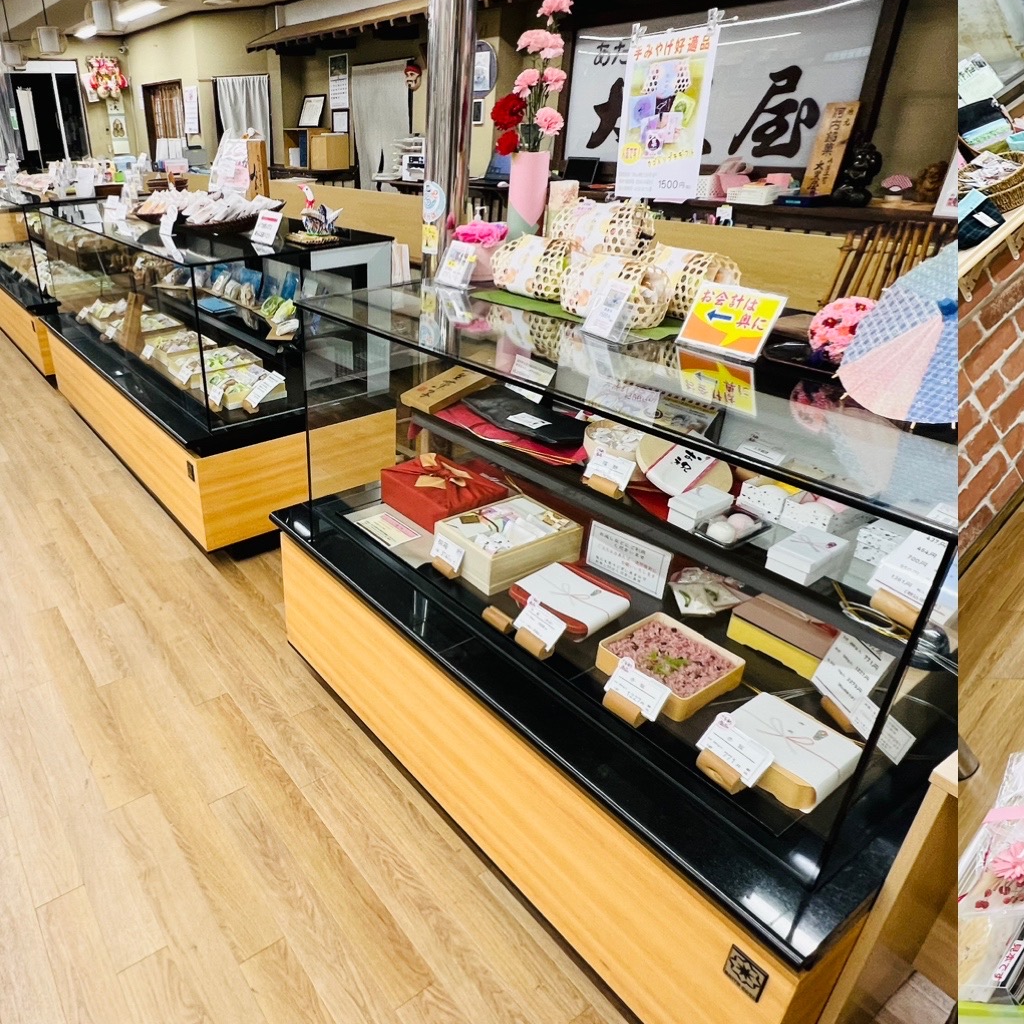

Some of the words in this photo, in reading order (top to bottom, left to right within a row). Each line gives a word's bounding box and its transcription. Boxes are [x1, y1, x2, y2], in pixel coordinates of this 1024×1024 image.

[701, 290, 758, 312] お会計は
[736, 313, 767, 331] 奥に
